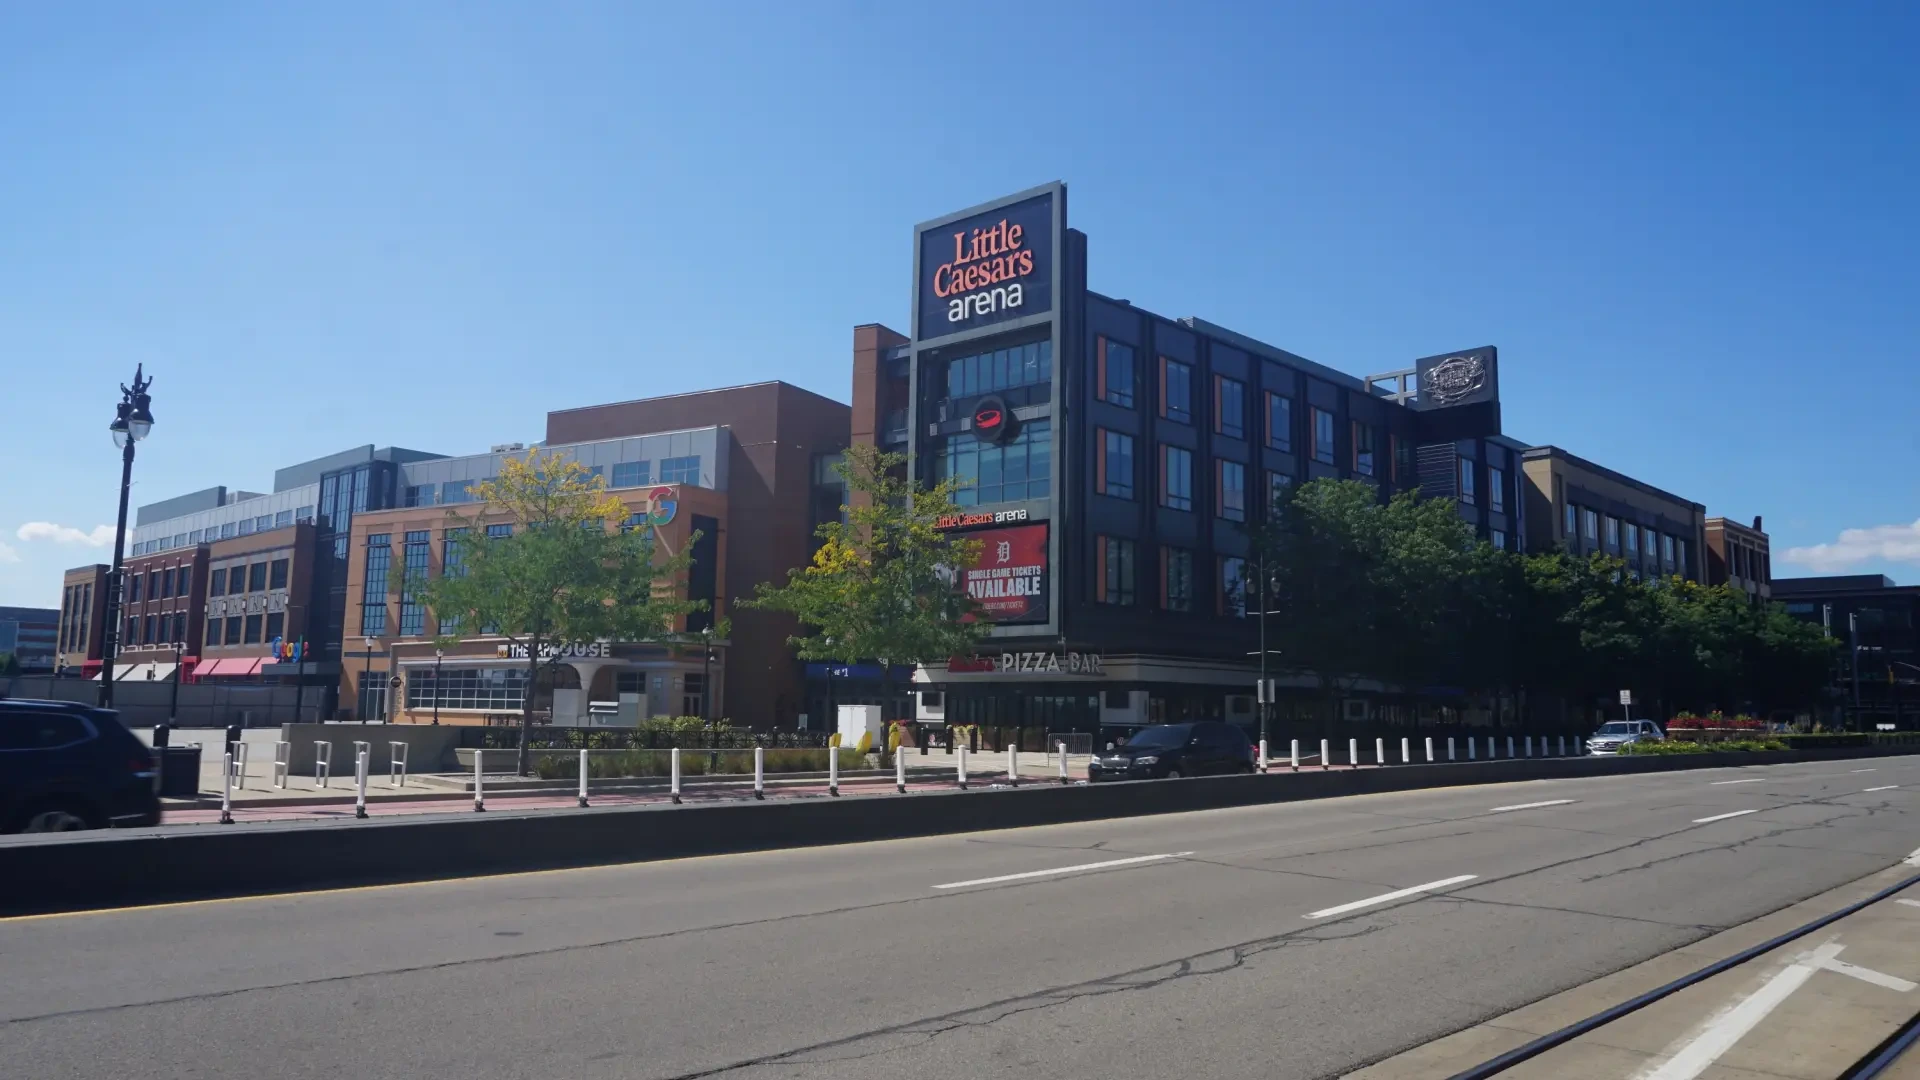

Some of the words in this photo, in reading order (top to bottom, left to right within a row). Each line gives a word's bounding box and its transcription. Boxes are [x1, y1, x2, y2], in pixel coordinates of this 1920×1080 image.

[954, 219, 1021, 265] Little
[934, 249, 1033, 297] Caesars
[948, 283, 1023, 322] arena
[957, 512, 993, 525] Caesars
[995, 509, 1027, 522] arena
[968, 570, 990, 580] SINGLE
[991, 568, 1011, 578] GAME
[1012, 565, 1041, 577] TICKETS
[967, 577, 1040, 598] AVAILABLE
[272, 634, 309, 664] Google
[510, 643, 529, 657] THE
[1002, 652, 1060, 673] PIZZA
[1068, 652, 1101, 673] BAR
